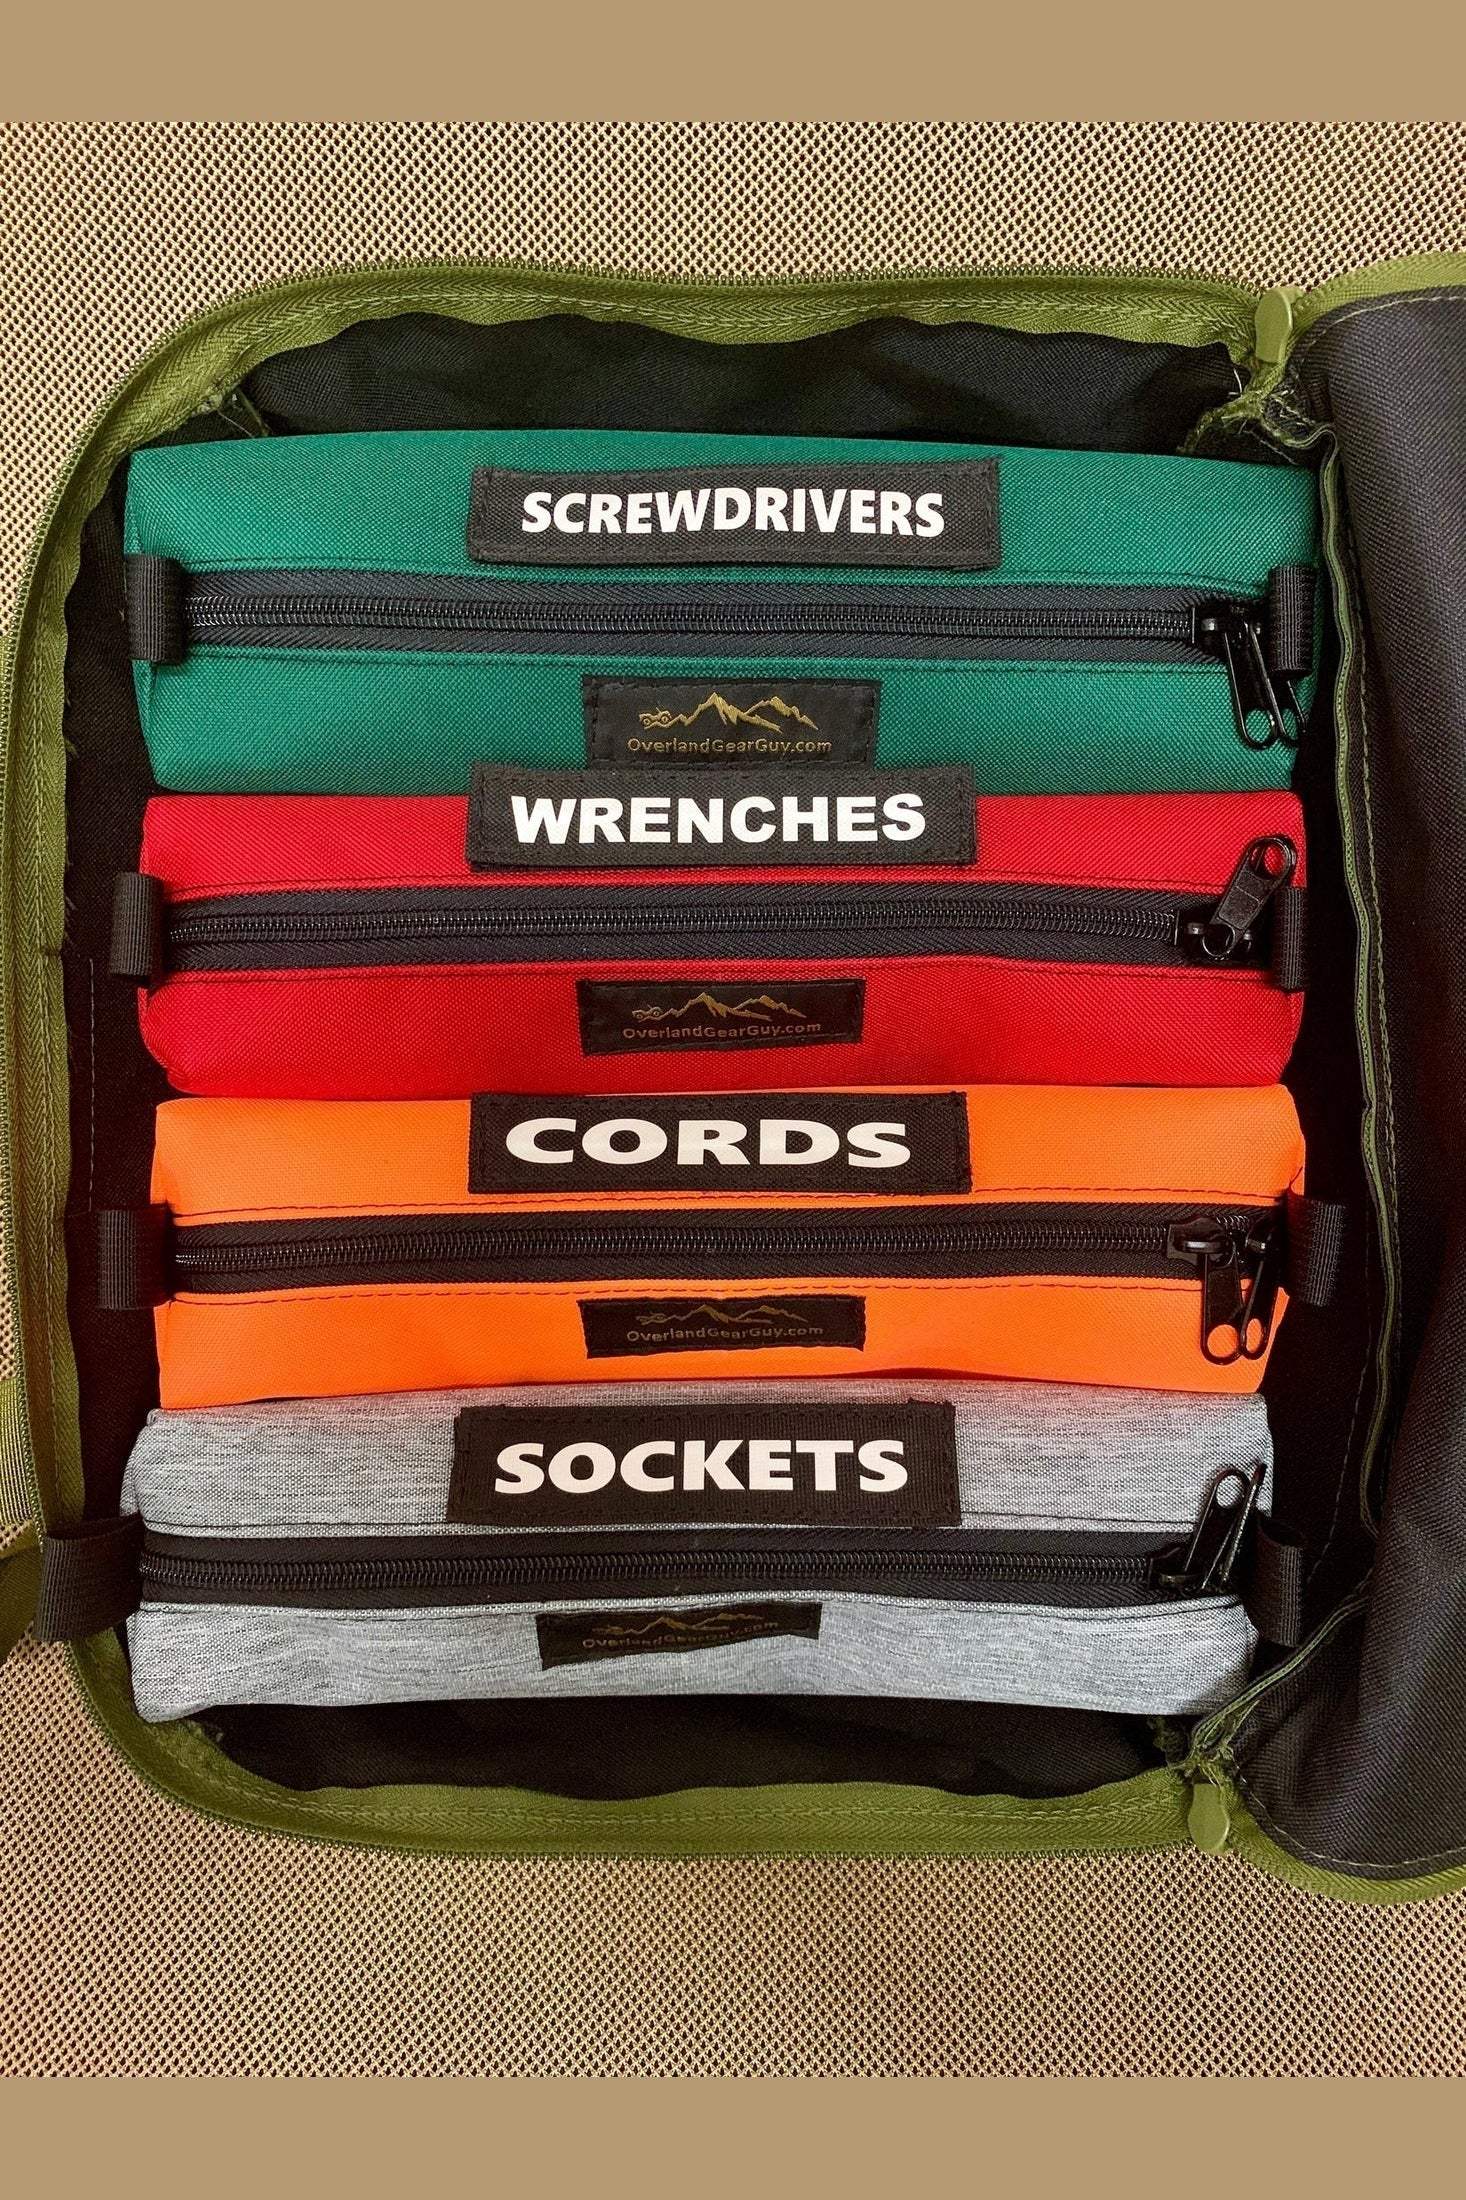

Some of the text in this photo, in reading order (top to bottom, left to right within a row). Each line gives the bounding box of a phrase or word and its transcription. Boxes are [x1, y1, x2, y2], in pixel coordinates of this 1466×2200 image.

[521, 487, 945, 538] SCREWDRIVERS
[626, 735, 833, 755] OverlandGearGuy.com
[510, 792, 926, 845] WRENCHES
[622, 1021, 822, 1040] OverlandGearGuy.com
[505, 1117, 911, 1169] CORDS
[626, 1326, 824, 1343] OverlandGearGuy.com
[494, 1439, 908, 1494] SOCKETS
